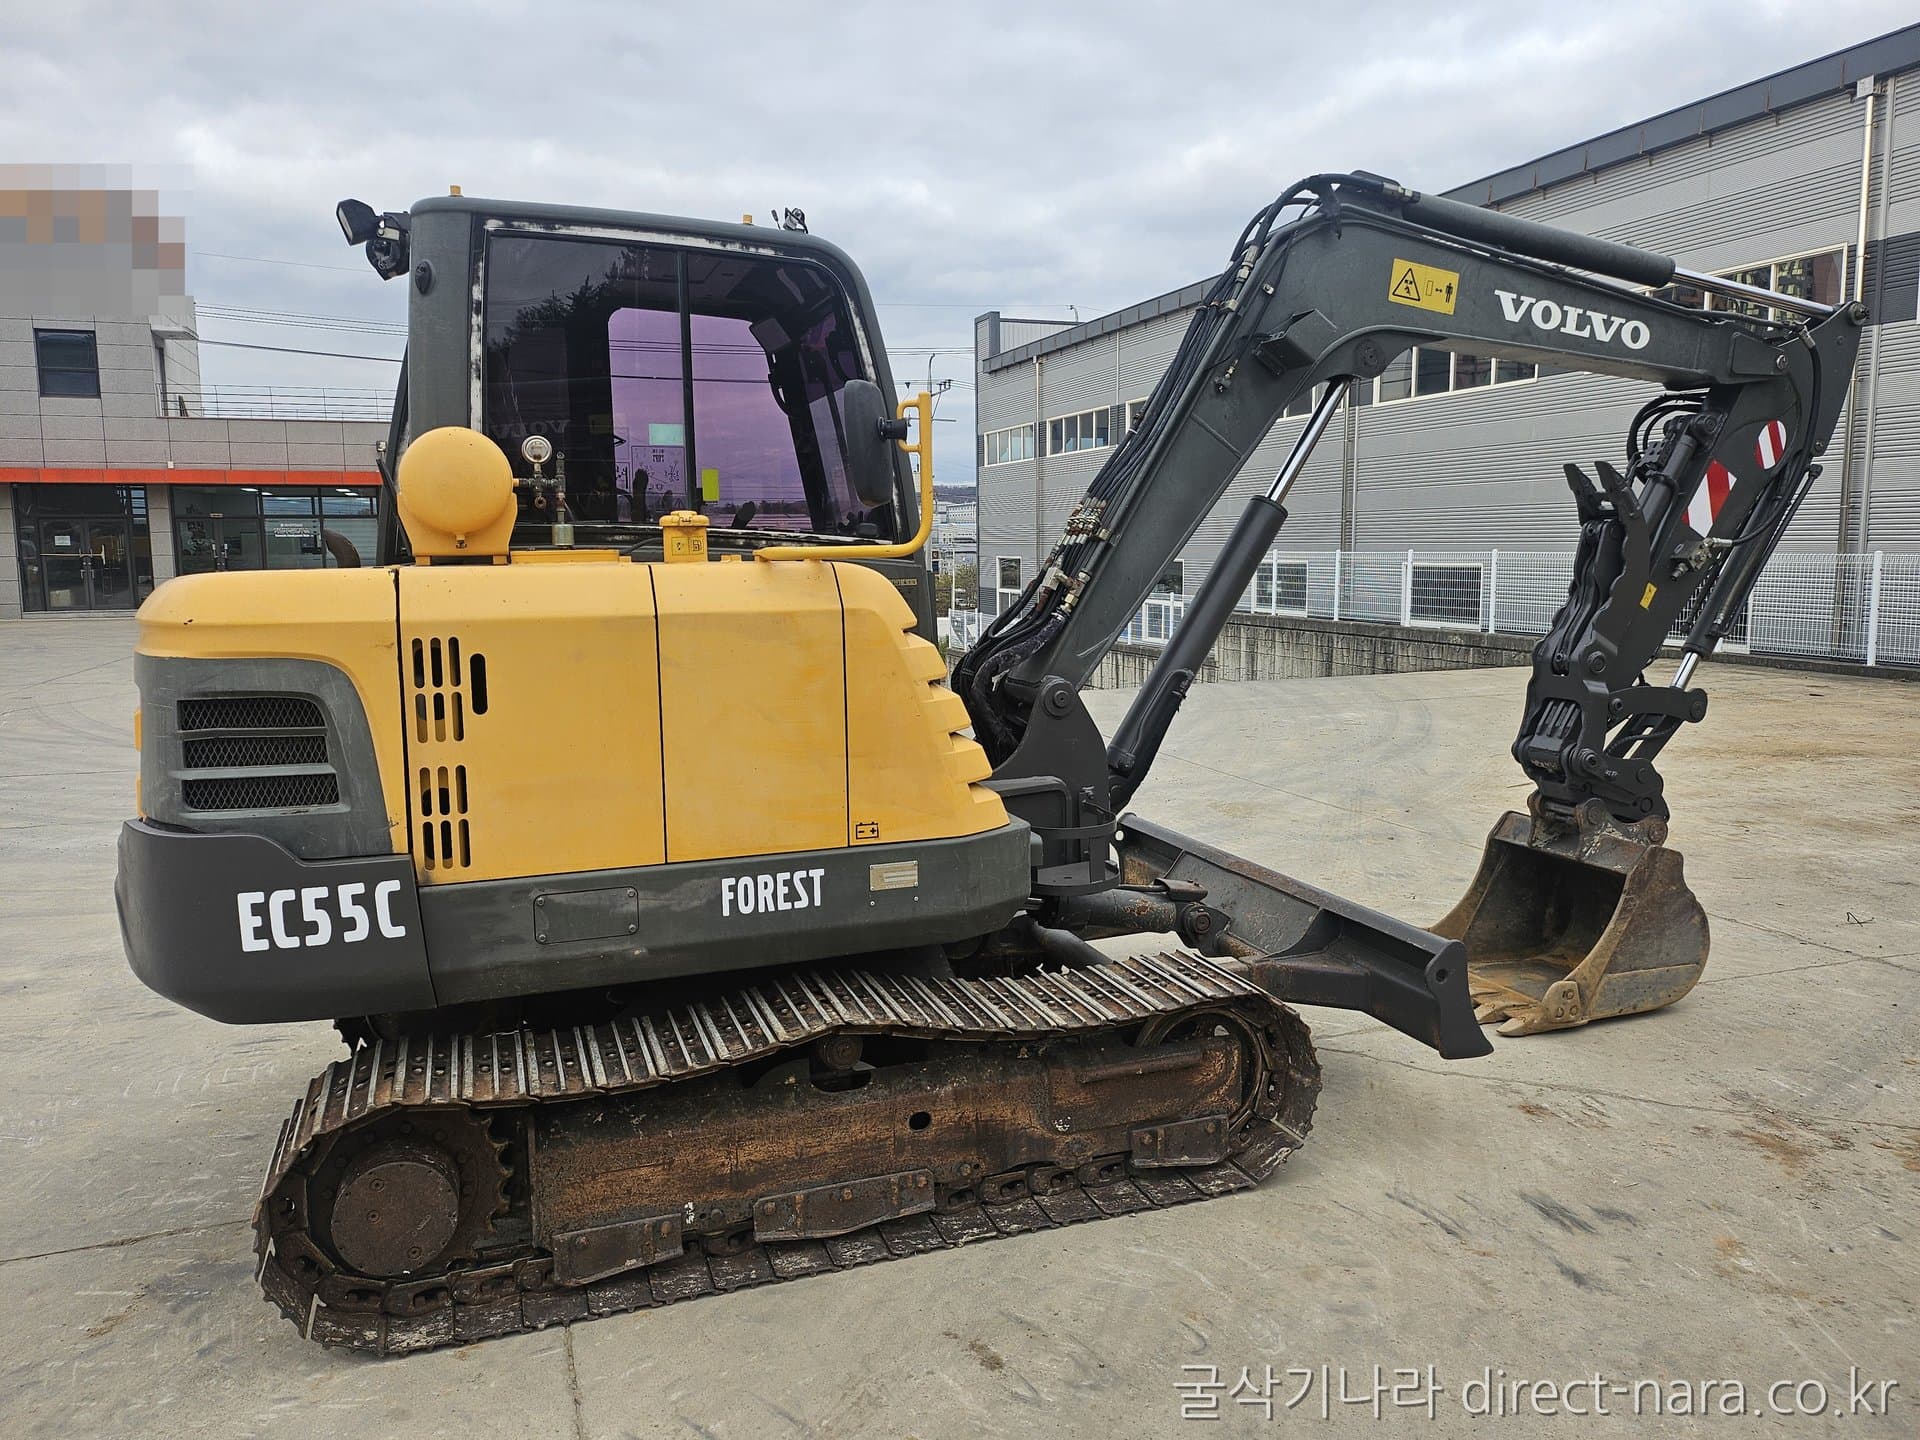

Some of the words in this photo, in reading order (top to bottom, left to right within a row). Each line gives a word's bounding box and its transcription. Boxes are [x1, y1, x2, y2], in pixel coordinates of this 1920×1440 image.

[1494, 288, 1651, 351] VOLVO
[237, 879, 406, 952] EC55C
[721, 868, 825, 917] FOREST
